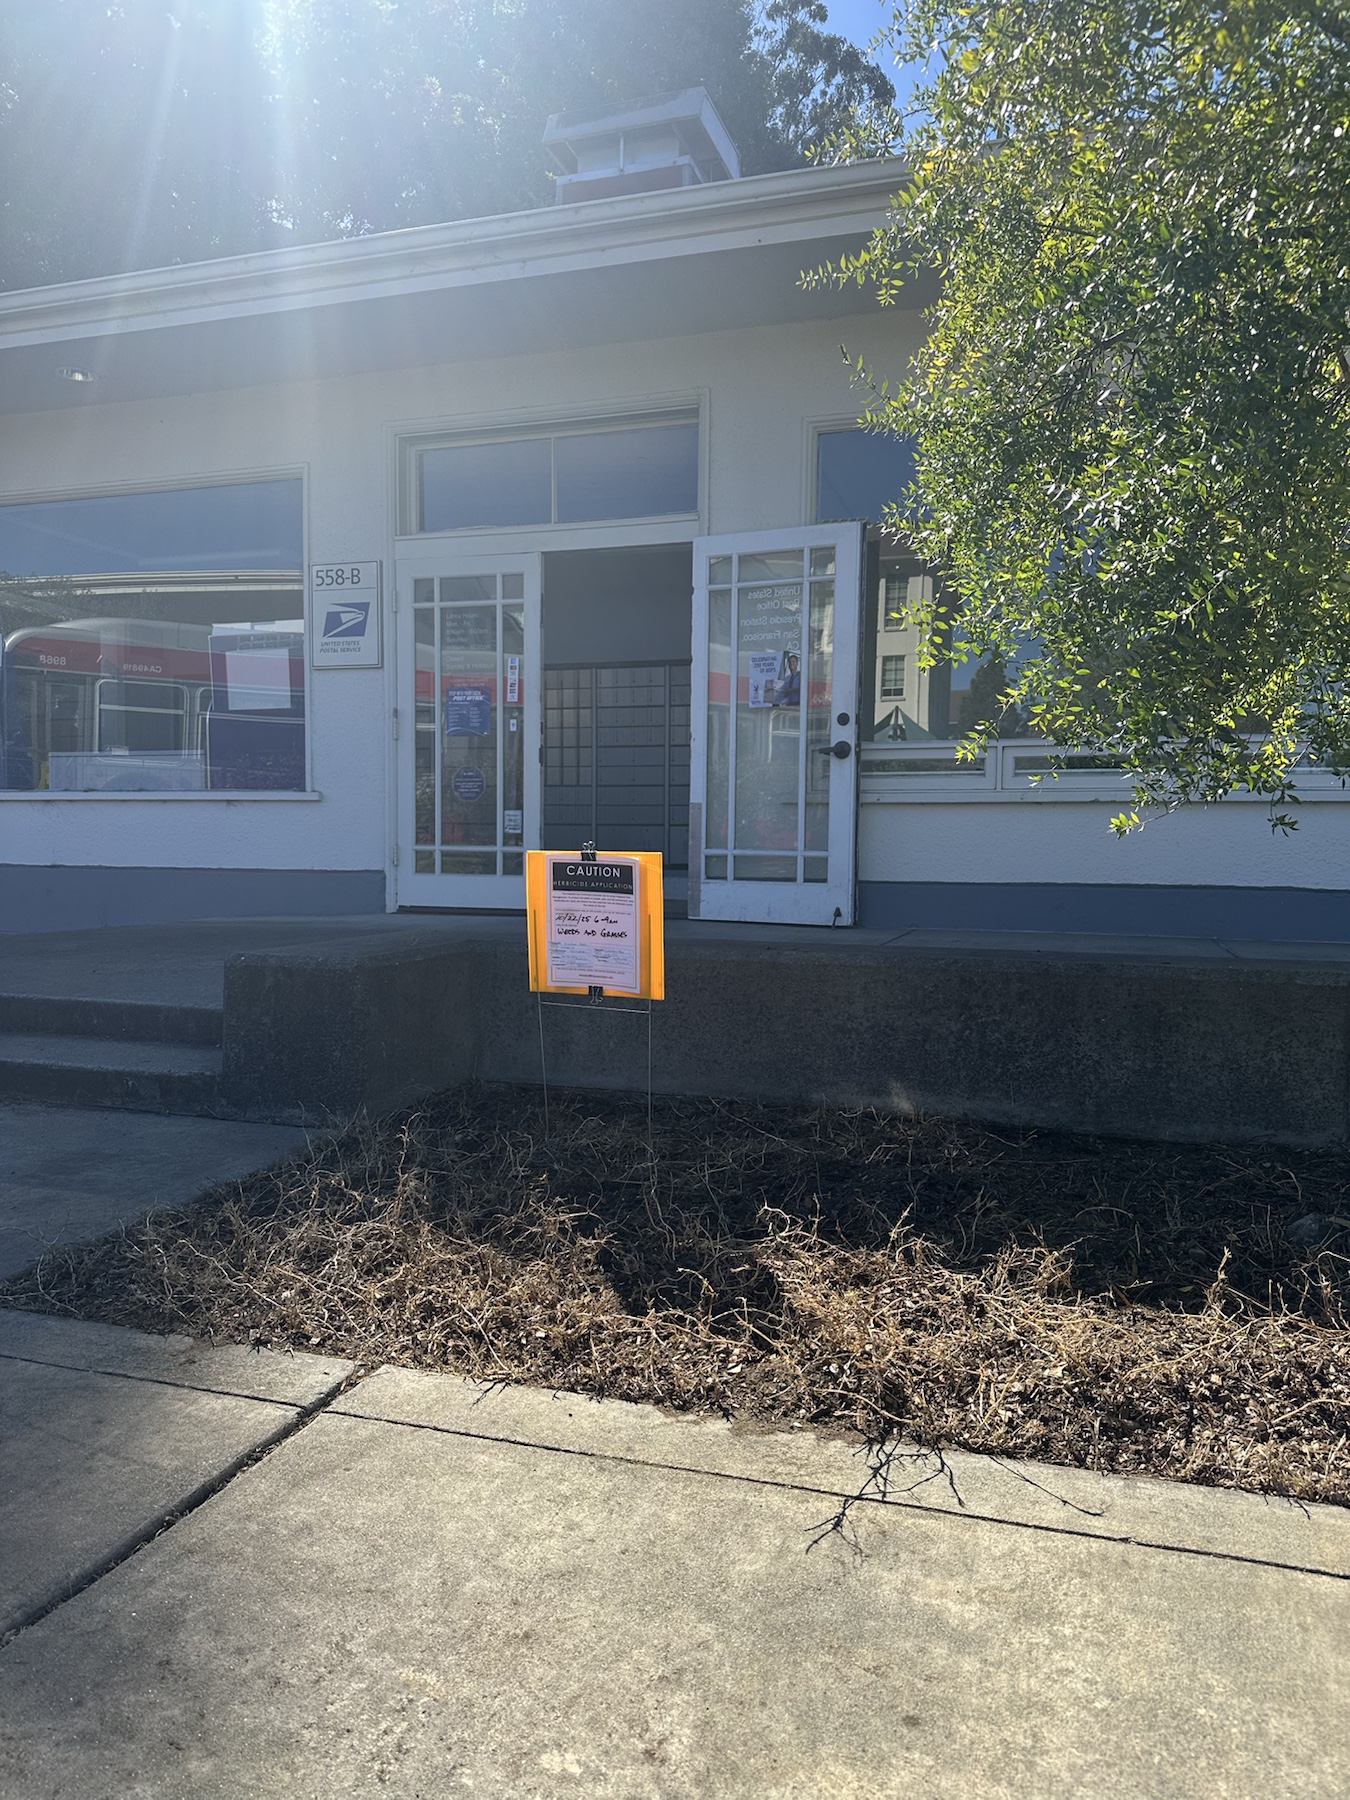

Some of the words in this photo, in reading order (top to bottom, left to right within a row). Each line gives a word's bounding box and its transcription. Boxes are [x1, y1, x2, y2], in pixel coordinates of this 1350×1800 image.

[316, 568, 361, 587] 558-B
[566, 865, 621, 878] CAUTION
[553, 880, 588, 888] HERBICIDE
[590, 881, 633, 890] APPLICATION
